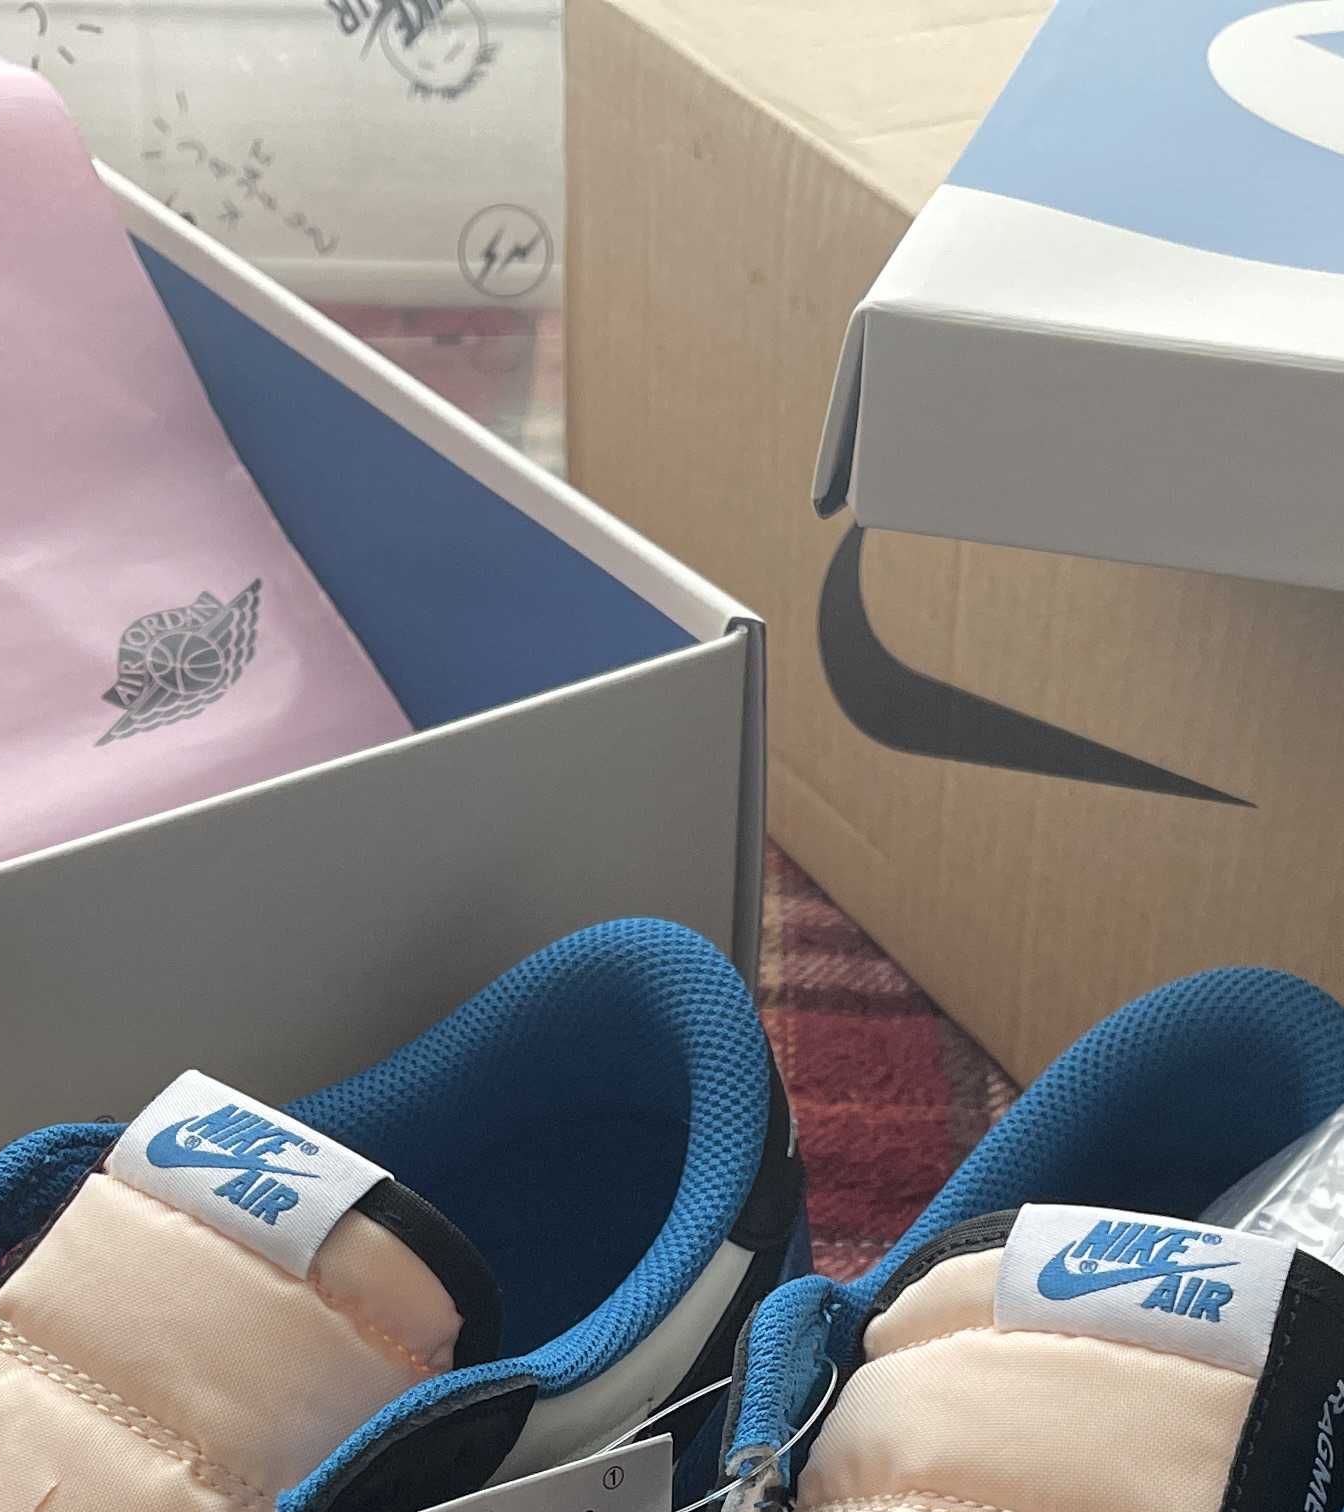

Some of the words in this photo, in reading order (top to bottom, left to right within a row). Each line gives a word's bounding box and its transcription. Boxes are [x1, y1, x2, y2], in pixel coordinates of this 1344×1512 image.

[114, 661, 147, 706] AIR
[184, 1104, 306, 1164] NIKE
[211, 1169, 300, 1226] AIR
[1070, 1219, 1202, 1267] NIKE
[1140, 1274, 1234, 1323] AIR
